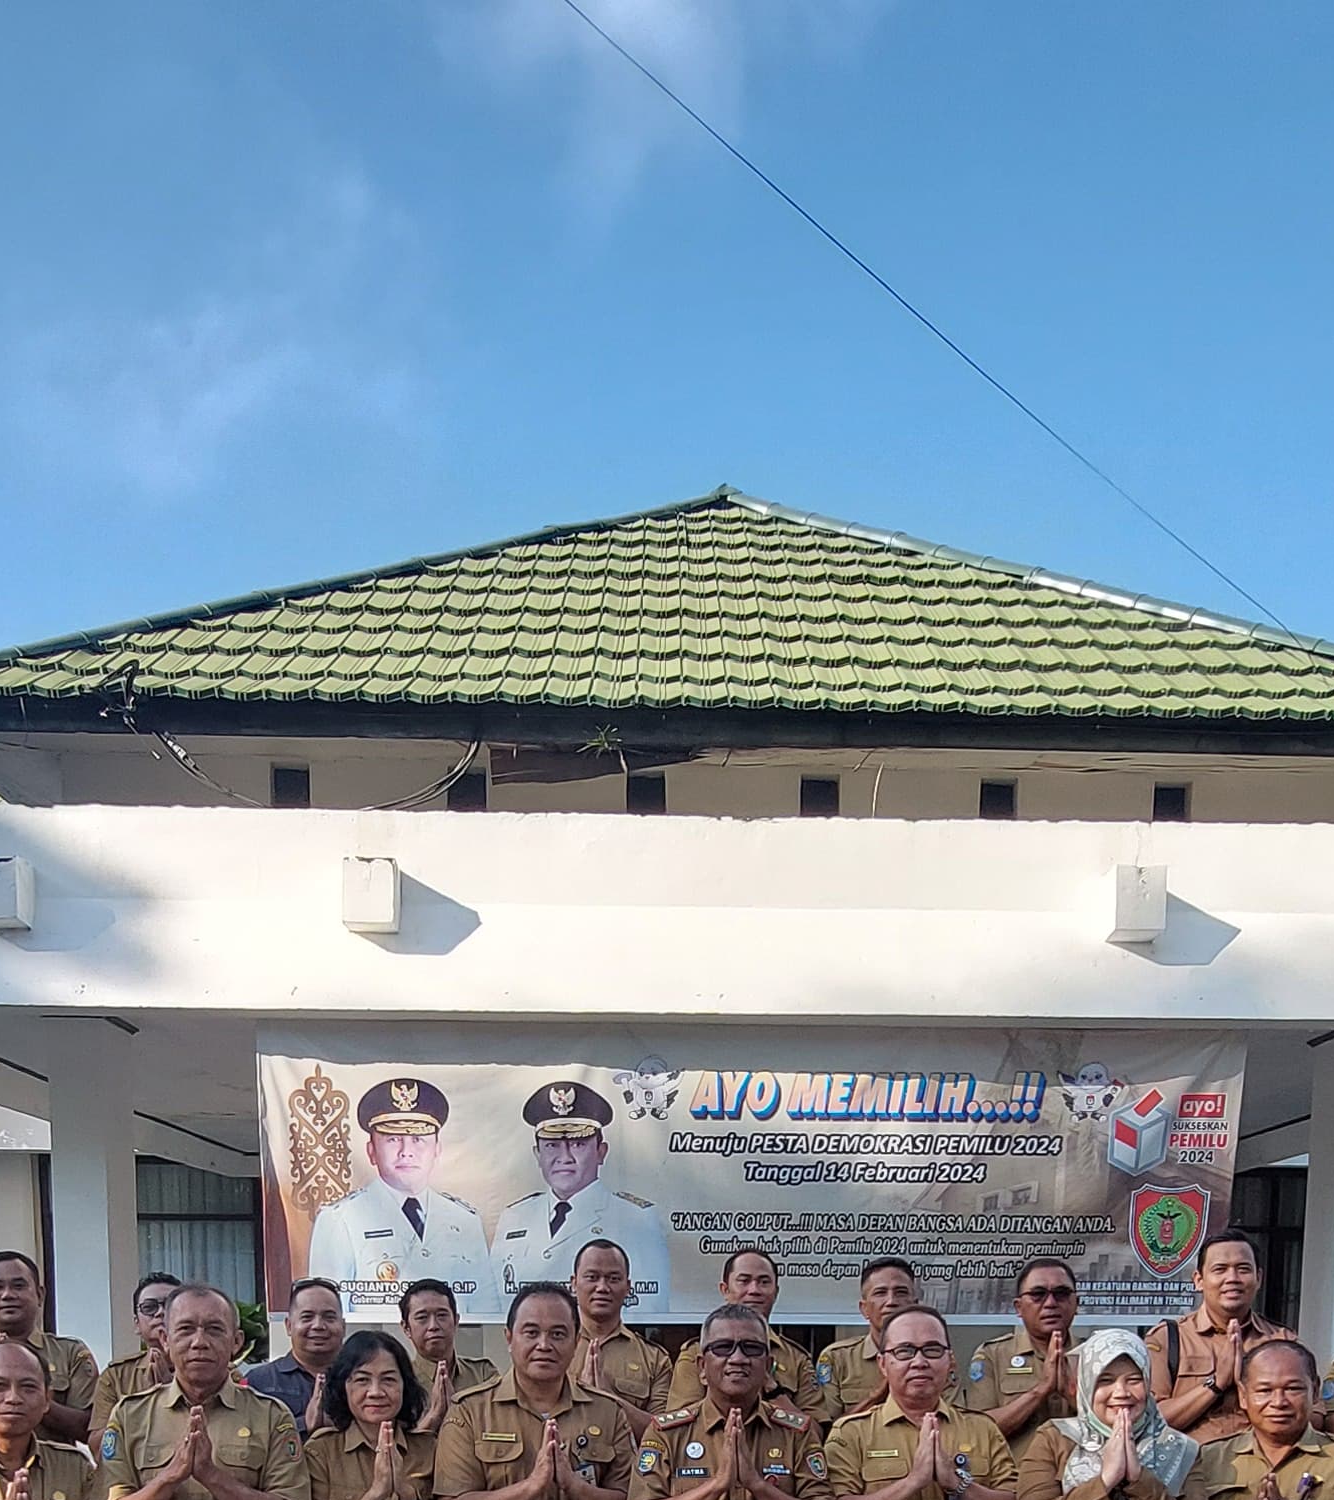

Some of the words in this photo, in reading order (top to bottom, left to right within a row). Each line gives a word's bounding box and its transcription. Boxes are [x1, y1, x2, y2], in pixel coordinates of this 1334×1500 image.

[690, 1071, 780, 1120] AYO
[1182, 1097, 1223, 1118] ayo!
[1171, 1121, 1228, 1131] SUKSESKAN
[670, 1134, 746, 1157] Menuju
[750, 1135, 809, 1154] PESTA
[812, 1135, 934, 1155] DEMOKRASI
[937, 1135, 1010, 1154] PEMILU
[1011, 1136, 1062, 1155] 2024
[1169, 1133, 1228, 1148] PEMILU
[1178, 1150, 1214, 1163] 2024
[745, 1163, 822, 1184] Tanggal
[826, 1164, 849, 1182] 14
[853, 1164, 934, 1183] Februari
[936, 1165, 987, 1183] 2024
[816, 1213, 855, 1231] MASA
[858, 1214, 905, 1231] DEPAN
[907, 1214, 963, 1232] BANGSA
[966, 1215, 997, 1232] ADA
[1000, 1215, 1073, 1232] DITANGAN
[1075, 1215, 1116, 1232] ANDA.
[700, 1236, 755, 1253] Gunakan
[758, 1236, 780, 1253] hak
[782, 1236, 813, 1256] pilih
[815, 1236, 828, 1253] di
[830, 1236, 872, 1254] Pemilu
[873, 1237, 906, 1254] 2024
[909, 1238, 945, 1254] untuk
[948, 1239, 1023, 1255] menentukan
[1026, 1240, 1085, 1258] pemimpin
[787, 1264, 819, 1277] masa
[822, 1260, 860, 1280] depan
[923, 1264, 953, 1280] yang
[956, 1261, 987, 1278] lebih
[340, 1281, 399, 1293] SUGIANTO
[453, 1281, 476, 1293] S.IP
[505, 1282, 518, 1294] H.
[635, 1282, 658, 1294] M.M
[1092, 1282, 1131, 1291] KESATUAN
[1132, 1282, 1163, 1291] BANGSA
[1163, 1282, 1180, 1291] DAN
[351, 1294, 384, 1304] Gubernur
[1079, 1296, 1114, 1305] PROVINSI
[1115, 1296, 1163, 1305] KALIMANTAN
[1165, 1296, 1194, 1306] TENGAH
